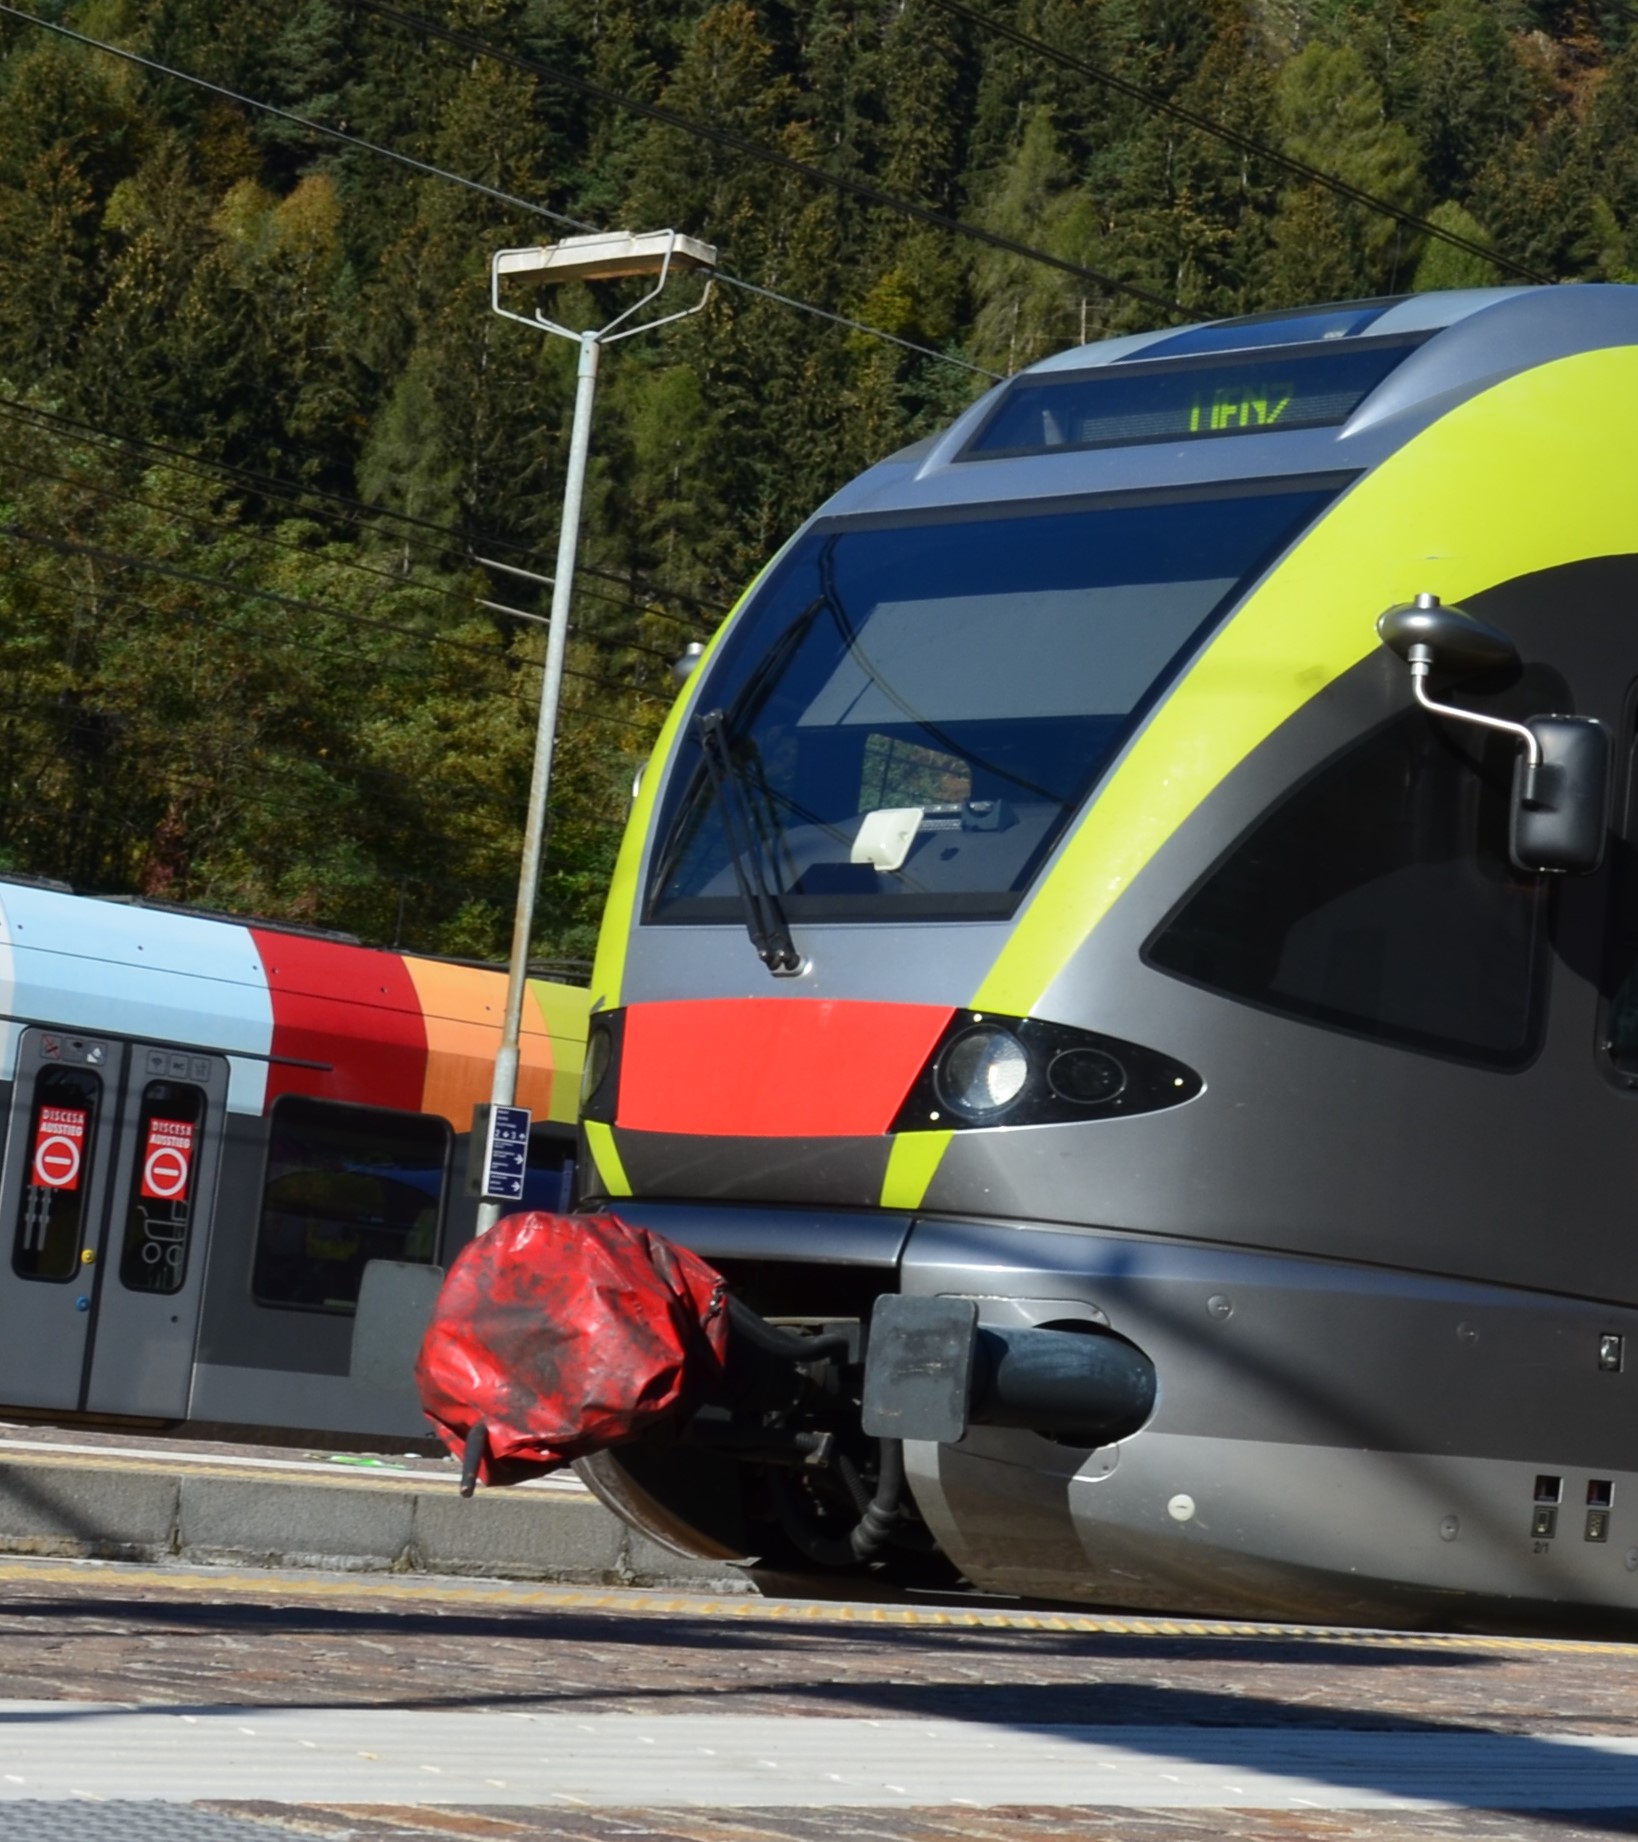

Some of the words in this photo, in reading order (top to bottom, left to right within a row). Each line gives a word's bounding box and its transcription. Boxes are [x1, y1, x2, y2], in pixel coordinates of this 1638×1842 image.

[43, 1109, 84, 1123] DISCESA
[41, 1122, 83, 1136] AUSSTIEG
[152, 1121, 192, 1135] DISCESA
[149, 1133, 191, 1149] AUSSTIEG
